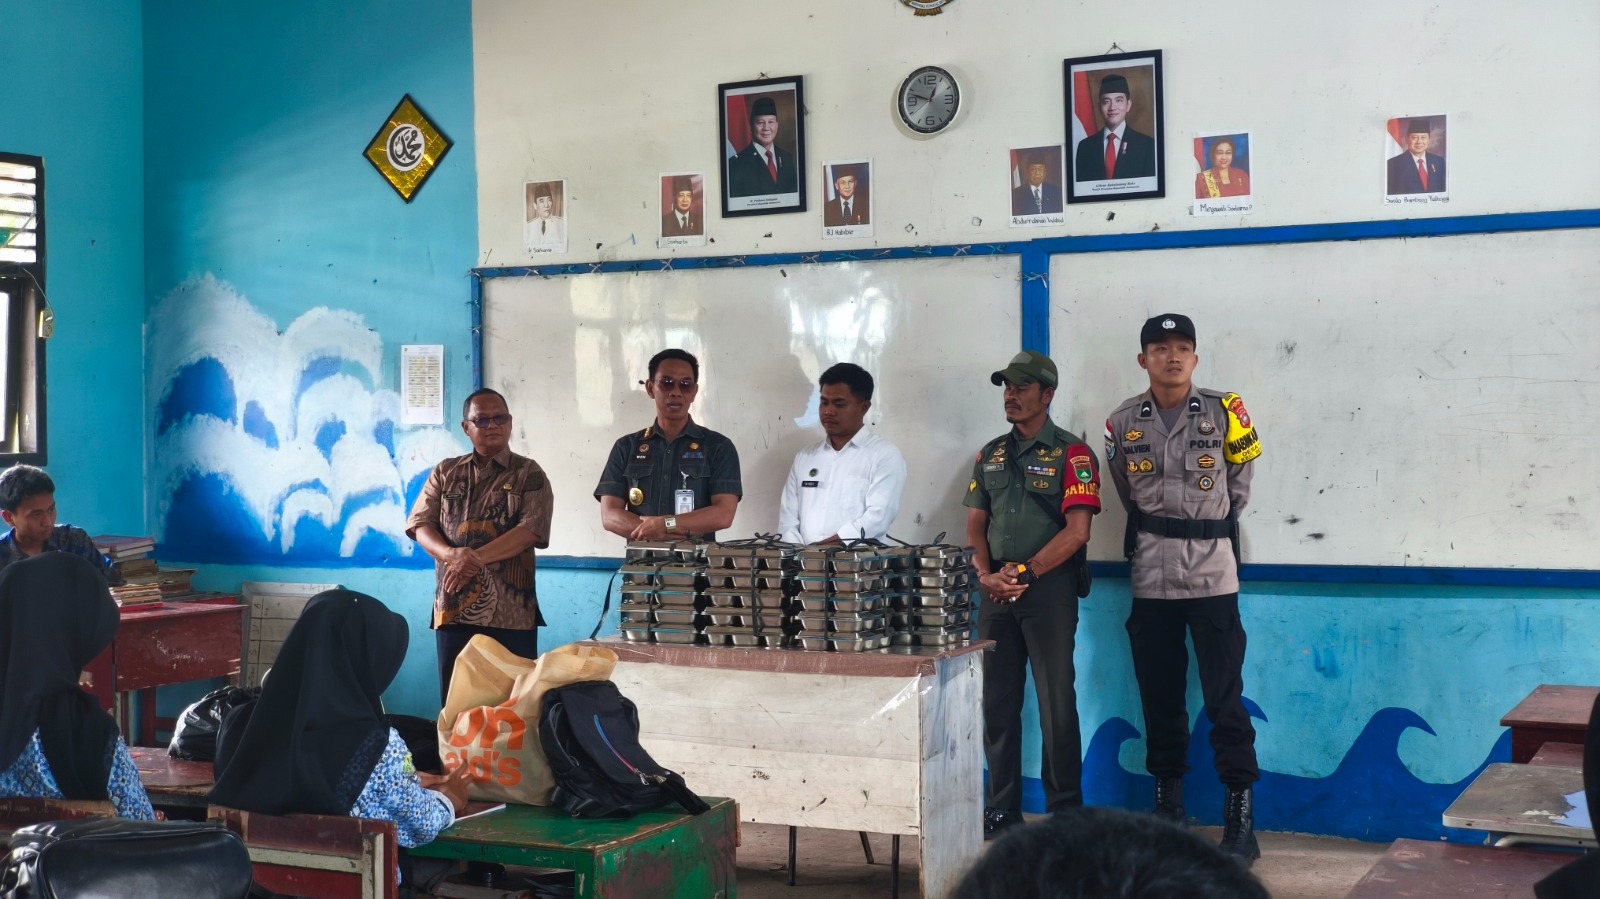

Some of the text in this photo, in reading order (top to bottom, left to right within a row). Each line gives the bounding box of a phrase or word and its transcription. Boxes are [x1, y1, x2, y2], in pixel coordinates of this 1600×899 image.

[924, 76, 936, 85] 12
[908, 97, 917, 106] 9
[944, 95, 953, 104] 3
[926, 116, 935, 125] 6
[1189, 440, 1222, 448] POLRI
